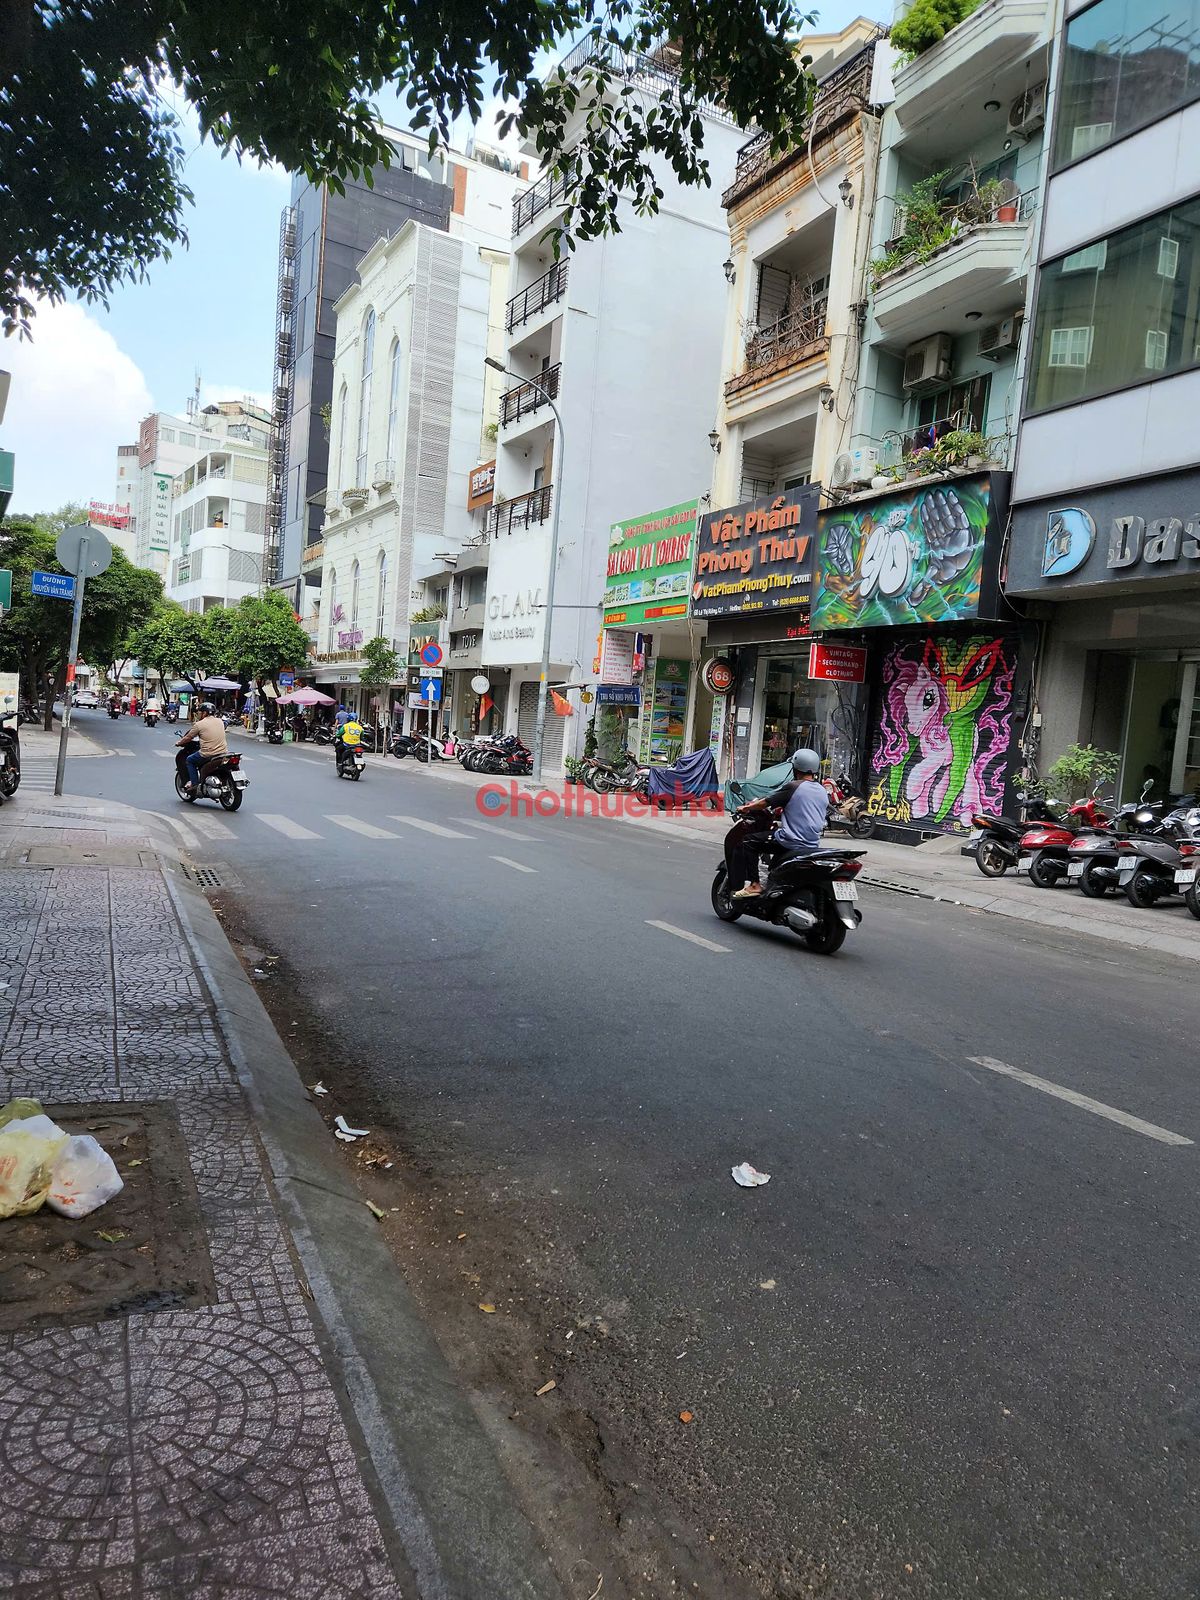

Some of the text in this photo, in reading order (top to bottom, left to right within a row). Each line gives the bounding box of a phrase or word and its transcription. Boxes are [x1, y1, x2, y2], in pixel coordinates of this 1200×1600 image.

[710, 495, 801, 549] Vật Phẩm
[655, 532, 693, 566] TOURIST
[698, 528, 810, 576] Phong Thủy
[42, 575, 66, 586] ĐƯỜNG
[830, 650, 854, 659] VINTAGE
[822, 659, 859, 669] SECONDHAND
[715, 671, 730, 681] 68
[826, 670, 854, 678] CLOTHING
